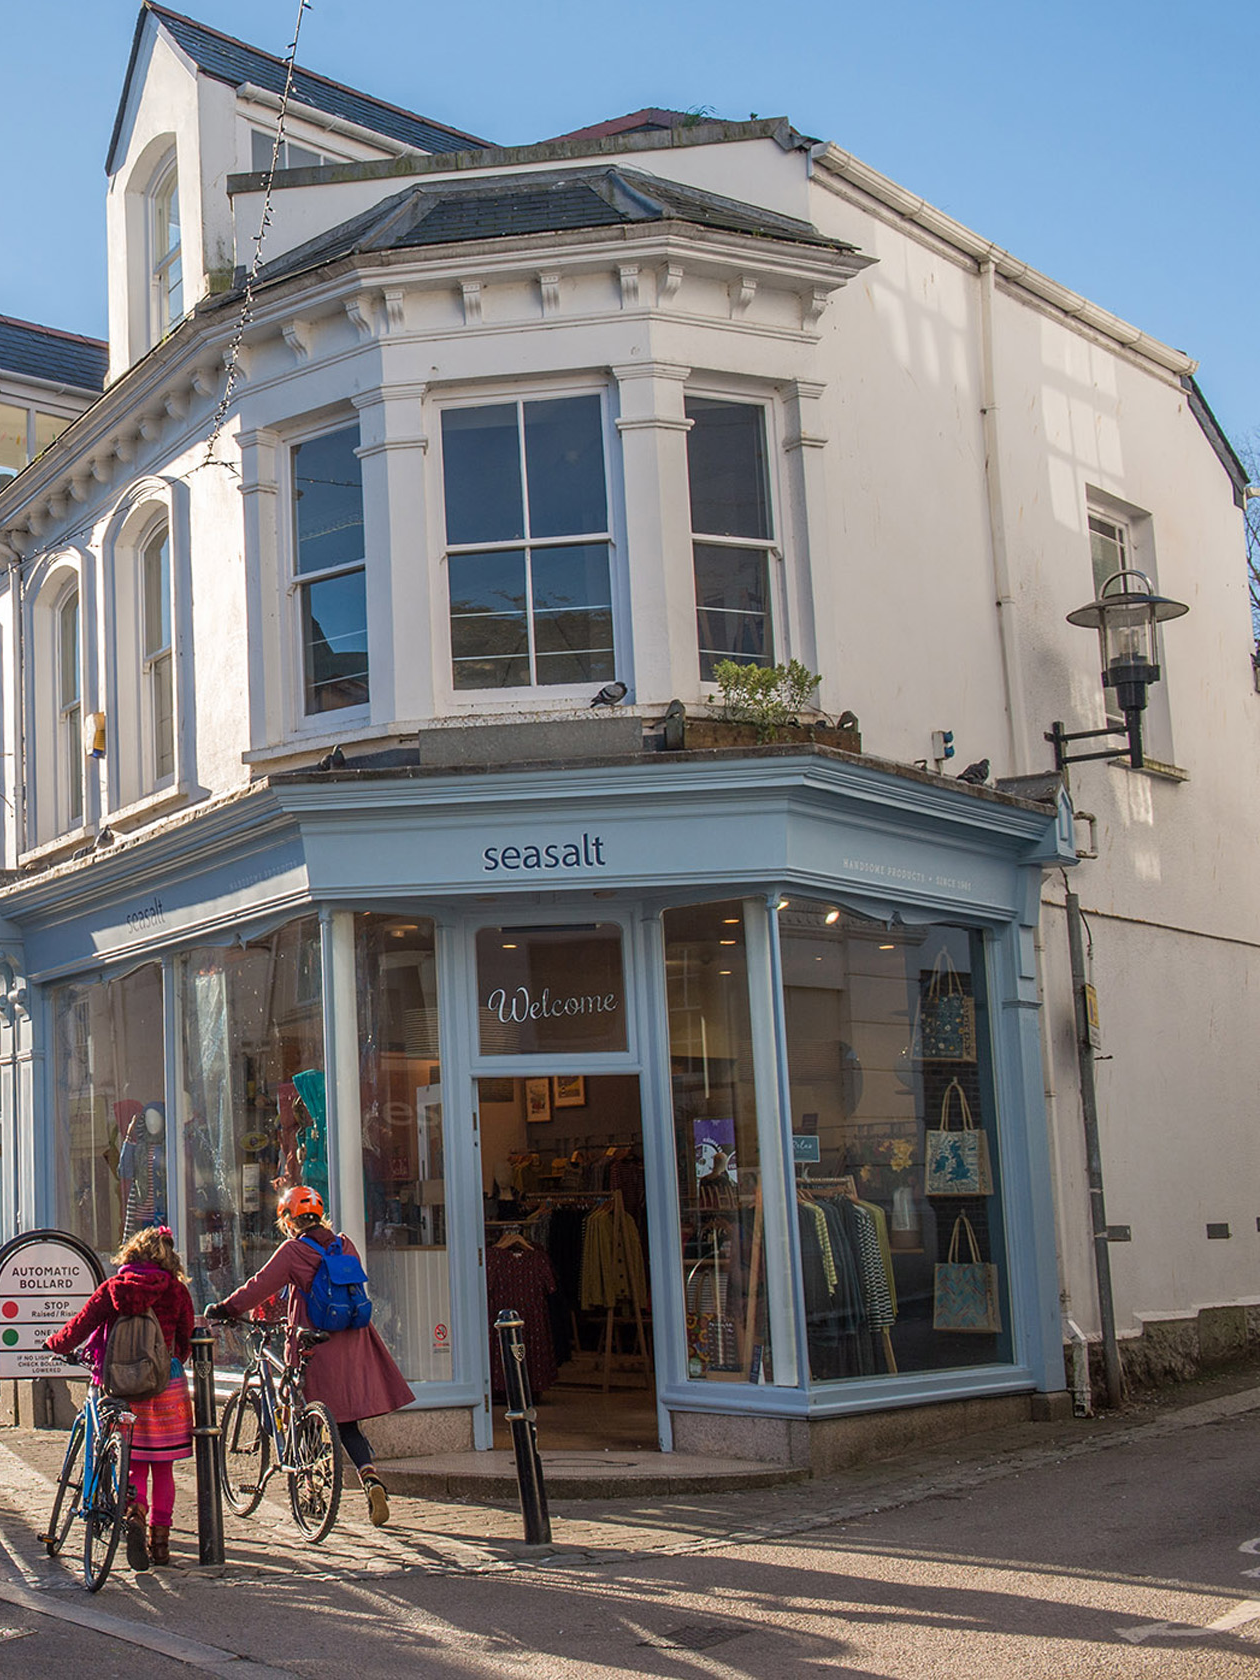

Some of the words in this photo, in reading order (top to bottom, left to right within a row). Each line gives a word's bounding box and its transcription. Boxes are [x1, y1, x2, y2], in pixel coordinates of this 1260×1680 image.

[483, 833, 607, 871] seasalt
[843, 859, 885, 875] HANDSOME
[887, 867, 925, 883] PRODUCTS
[126, 897, 166, 934] seasalt
[487, 986, 619, 1024] Welcome
[12, 1266, 80, 1277] AUTOMATIC
[20, 1279, 73, 1289] BOLLARD
[44, 1301, 70, 1310] STOP
